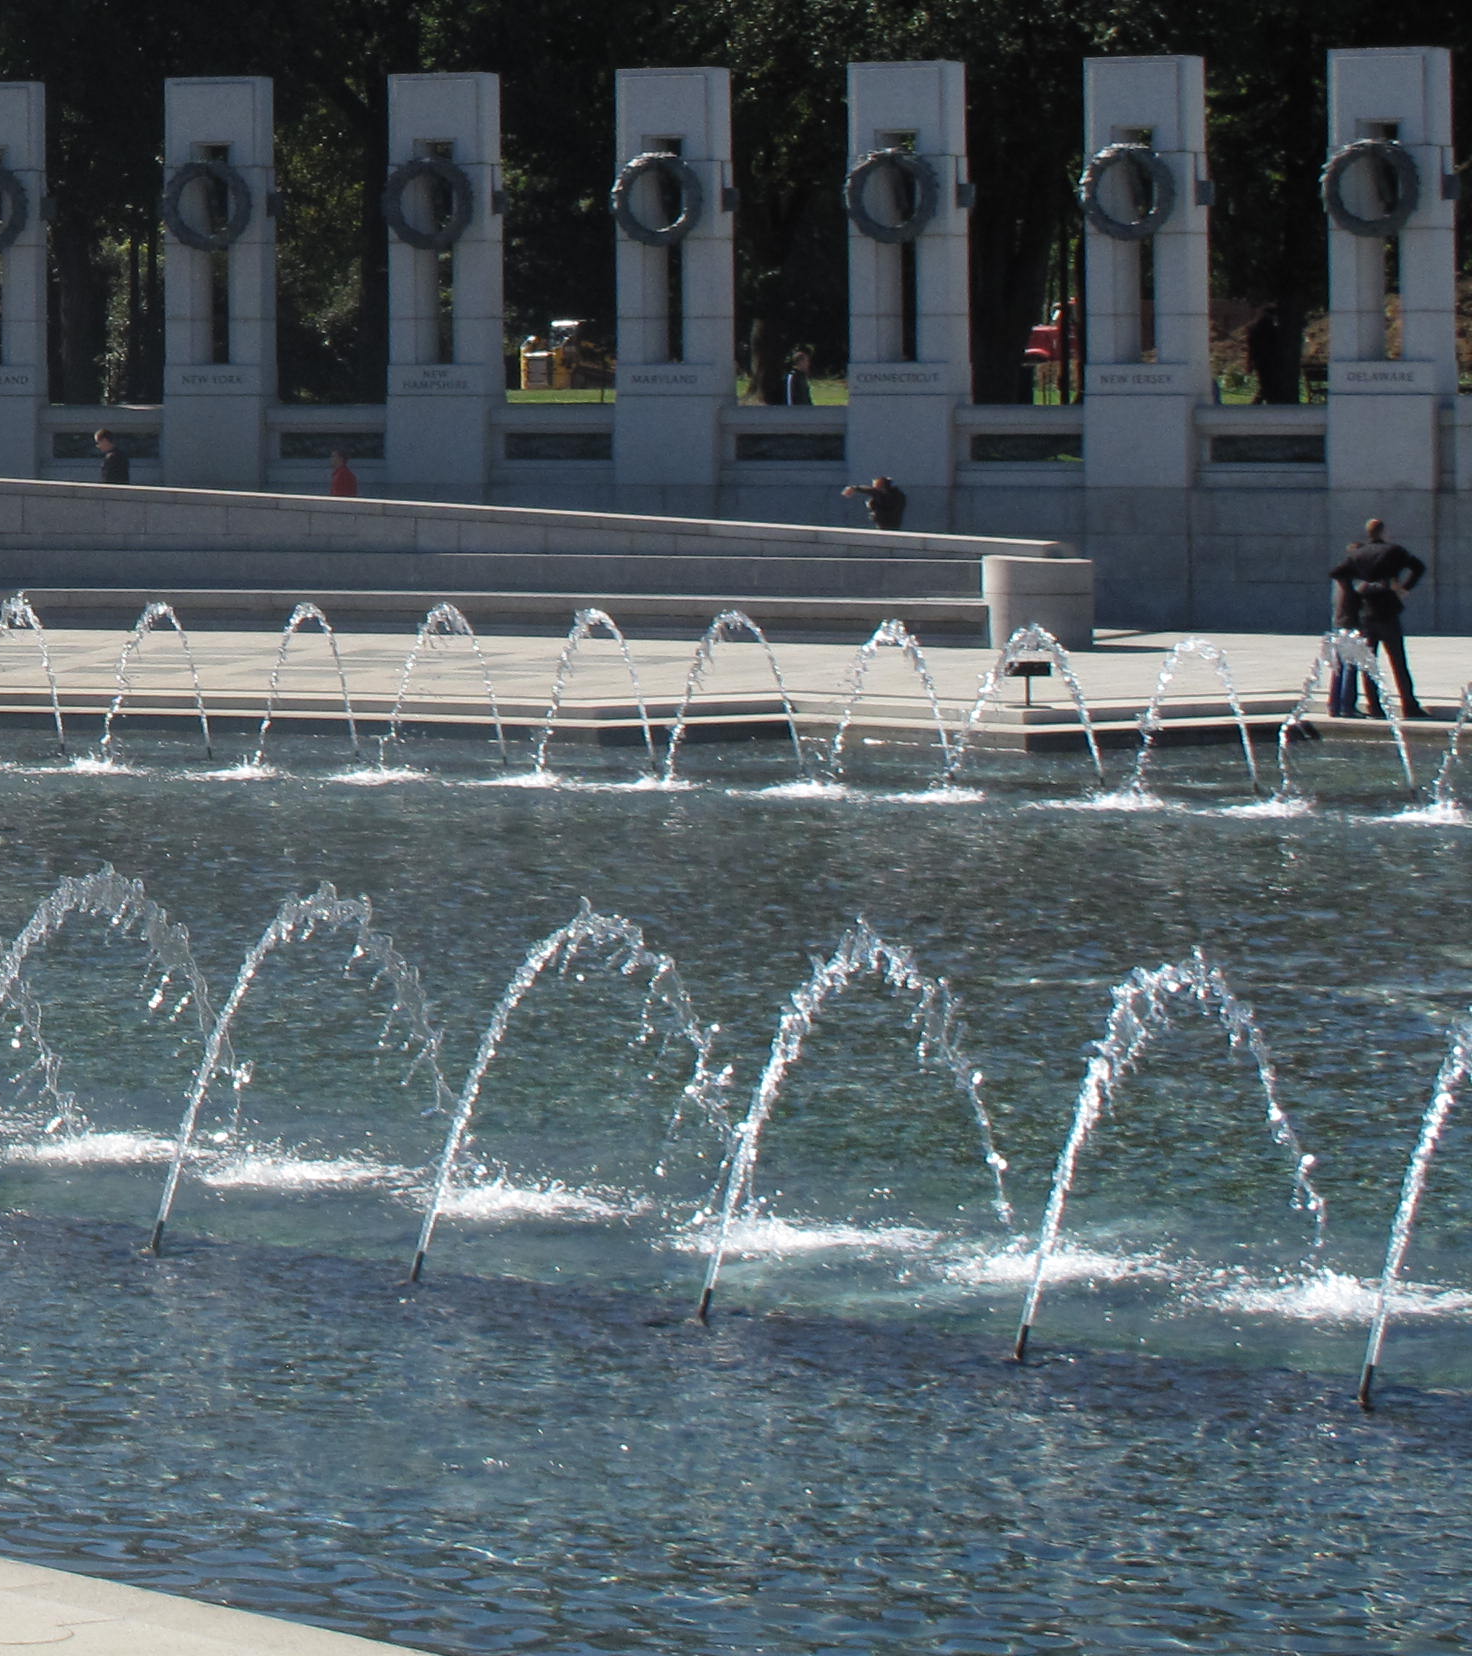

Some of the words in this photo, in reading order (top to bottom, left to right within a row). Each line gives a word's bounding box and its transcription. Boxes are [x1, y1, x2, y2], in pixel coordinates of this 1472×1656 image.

[181, 375, 208, 385] NEW
[212, 375, 243, 385] YORK
[631, 374, 698, 384] MARYLAND
[856, 372, 940, 383] CONNECTICUT
[1100, 374, 1128, 384] NEW
[1346, 371, 1415, 383] DELAWARE
